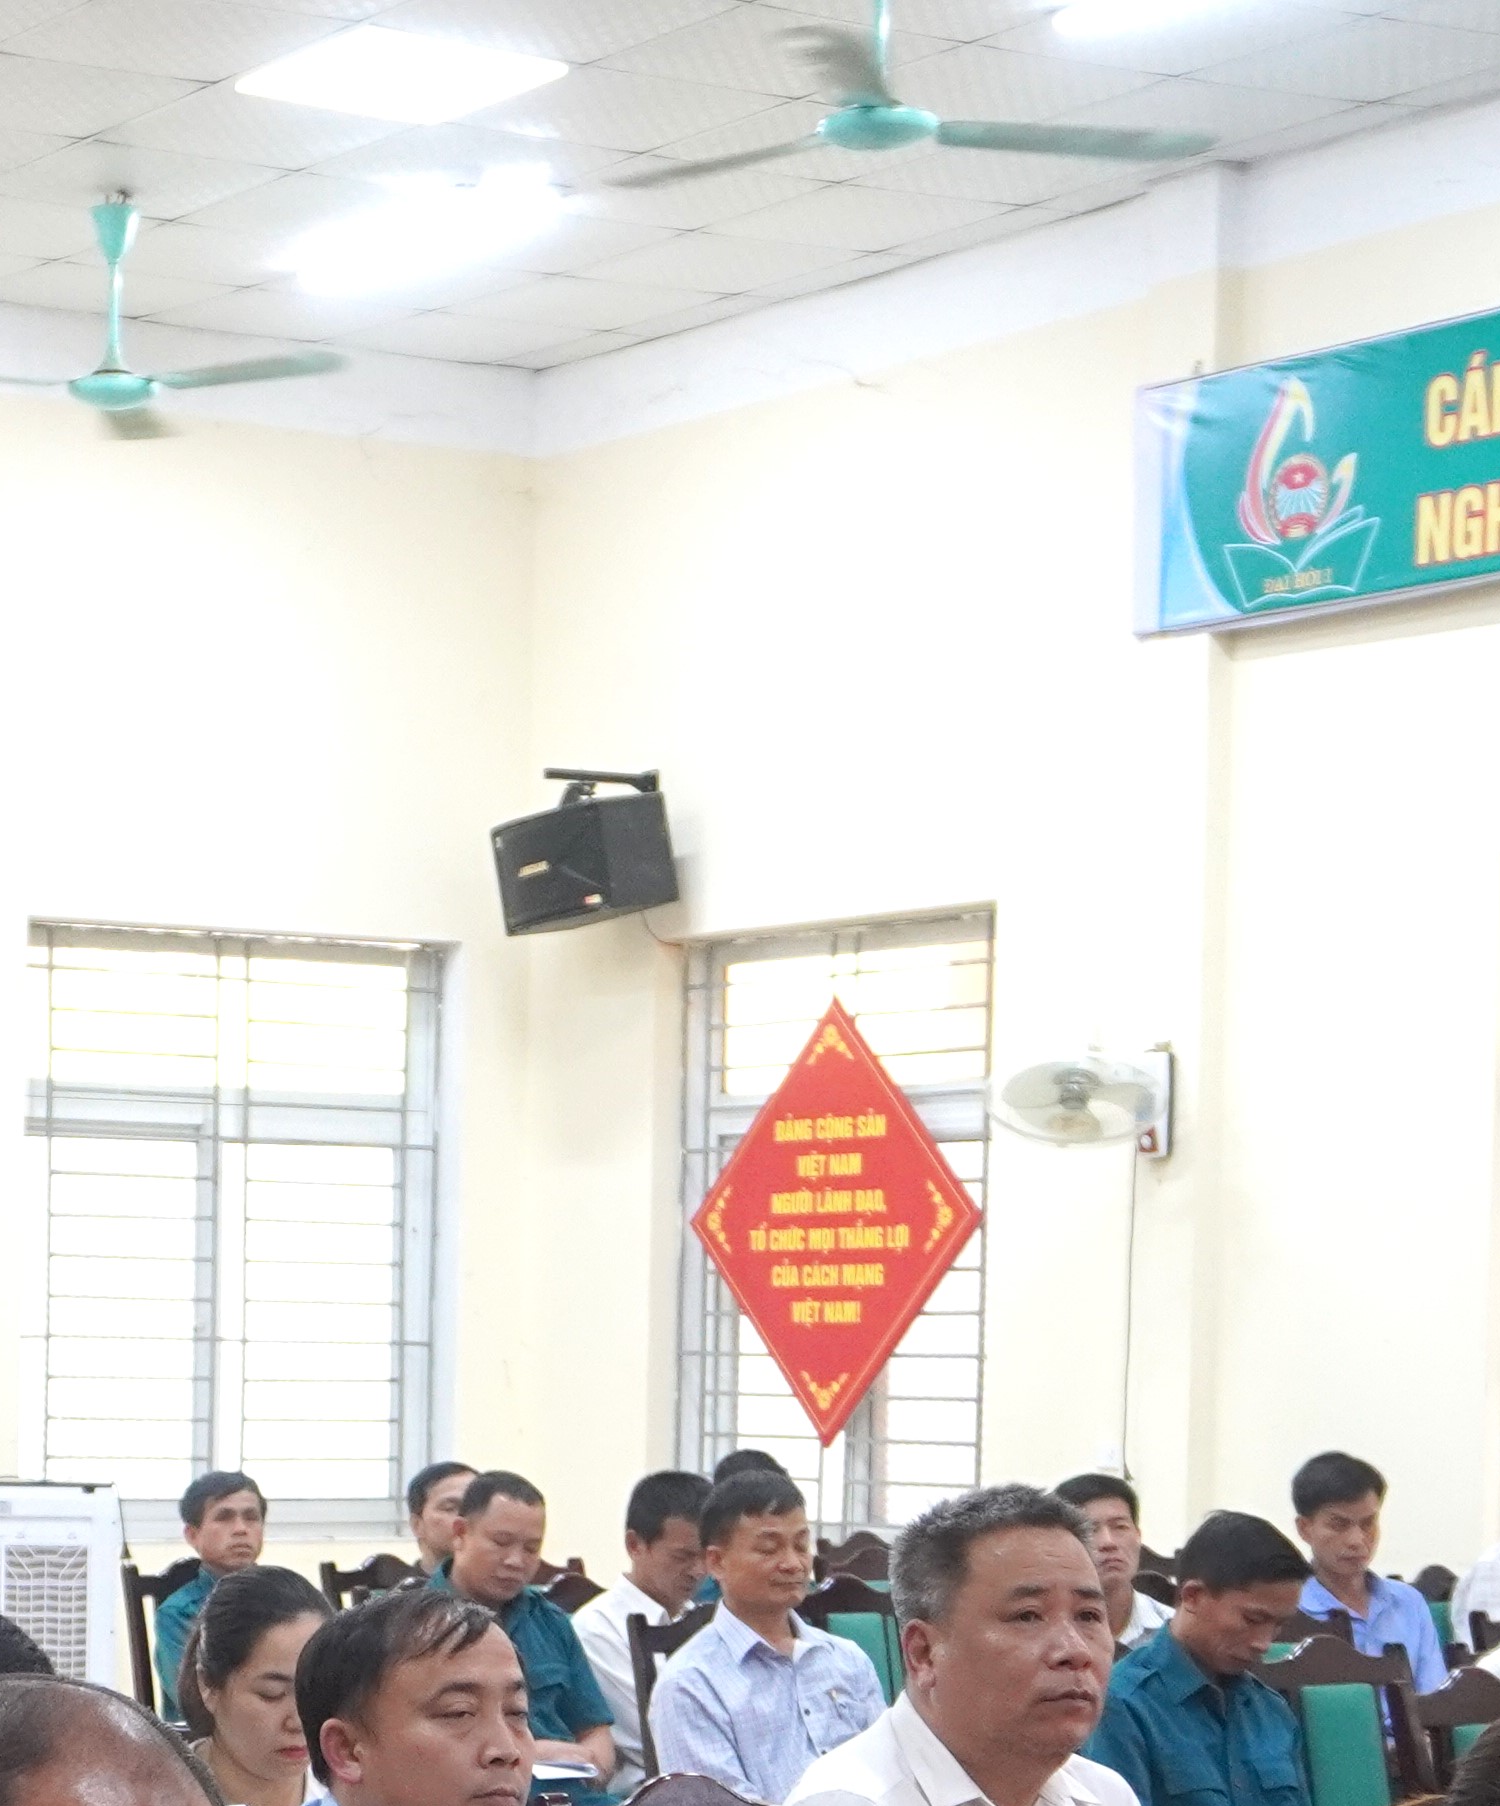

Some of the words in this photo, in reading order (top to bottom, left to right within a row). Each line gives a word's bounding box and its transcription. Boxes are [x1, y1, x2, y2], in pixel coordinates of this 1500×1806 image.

[774, 1112, 813, 1142] ĐẢNG
[815, 1112, 854, 1144] CỘNG
[856, 1107, 886, 1137] SẢN
[796, 1150, 826, 1181] VIỆT
[829, 1153, 862, 1176] NAM
[771, 1257, 799, 1287] CỦA
[803, 1260, 839, 1286] CÁCH
[842, 1263, 885, 1290] MẠNG
[791, 1296, 821, 1328] VIỆT
[823, 1300, 861, 1324] NAM!
